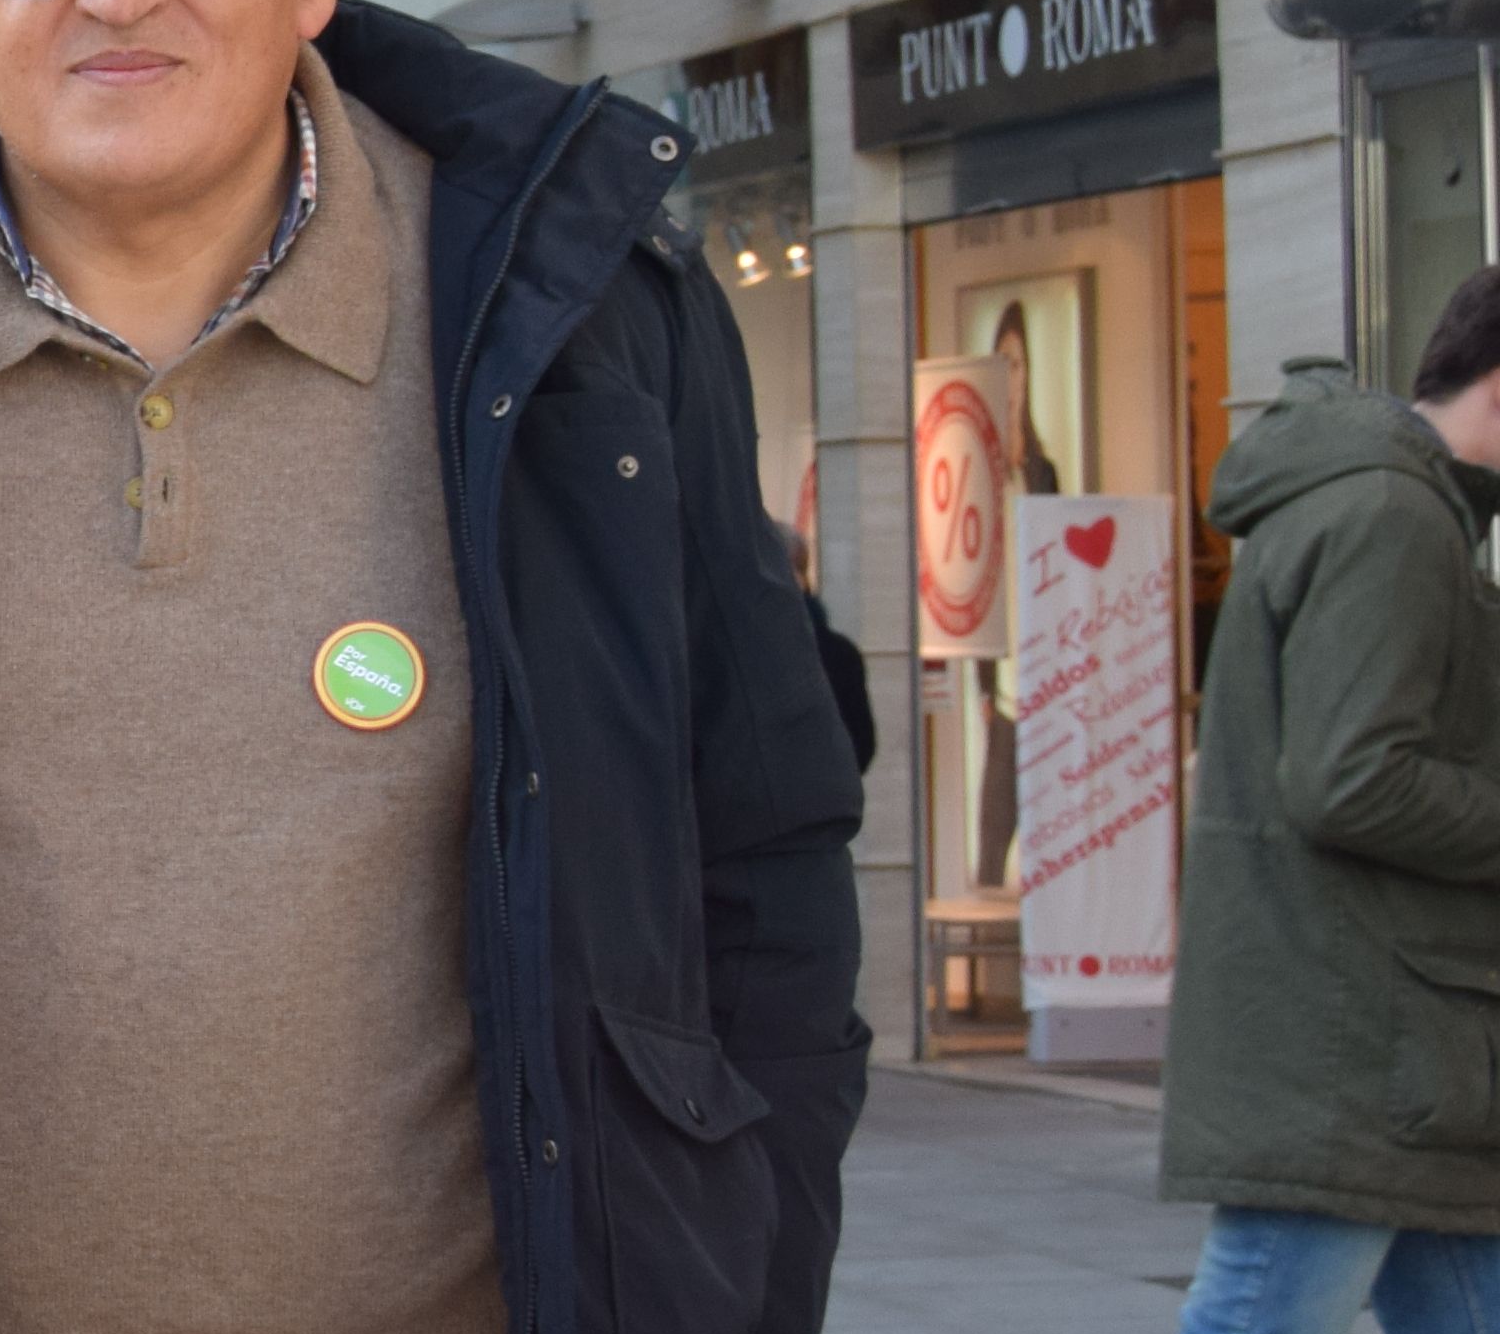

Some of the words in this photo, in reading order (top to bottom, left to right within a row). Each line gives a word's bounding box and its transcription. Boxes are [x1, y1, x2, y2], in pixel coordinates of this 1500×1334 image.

[900, 11, 992, 103] PUNT
[343, 644, 368, 662] Por
[333, 654, 404, 698] España.
